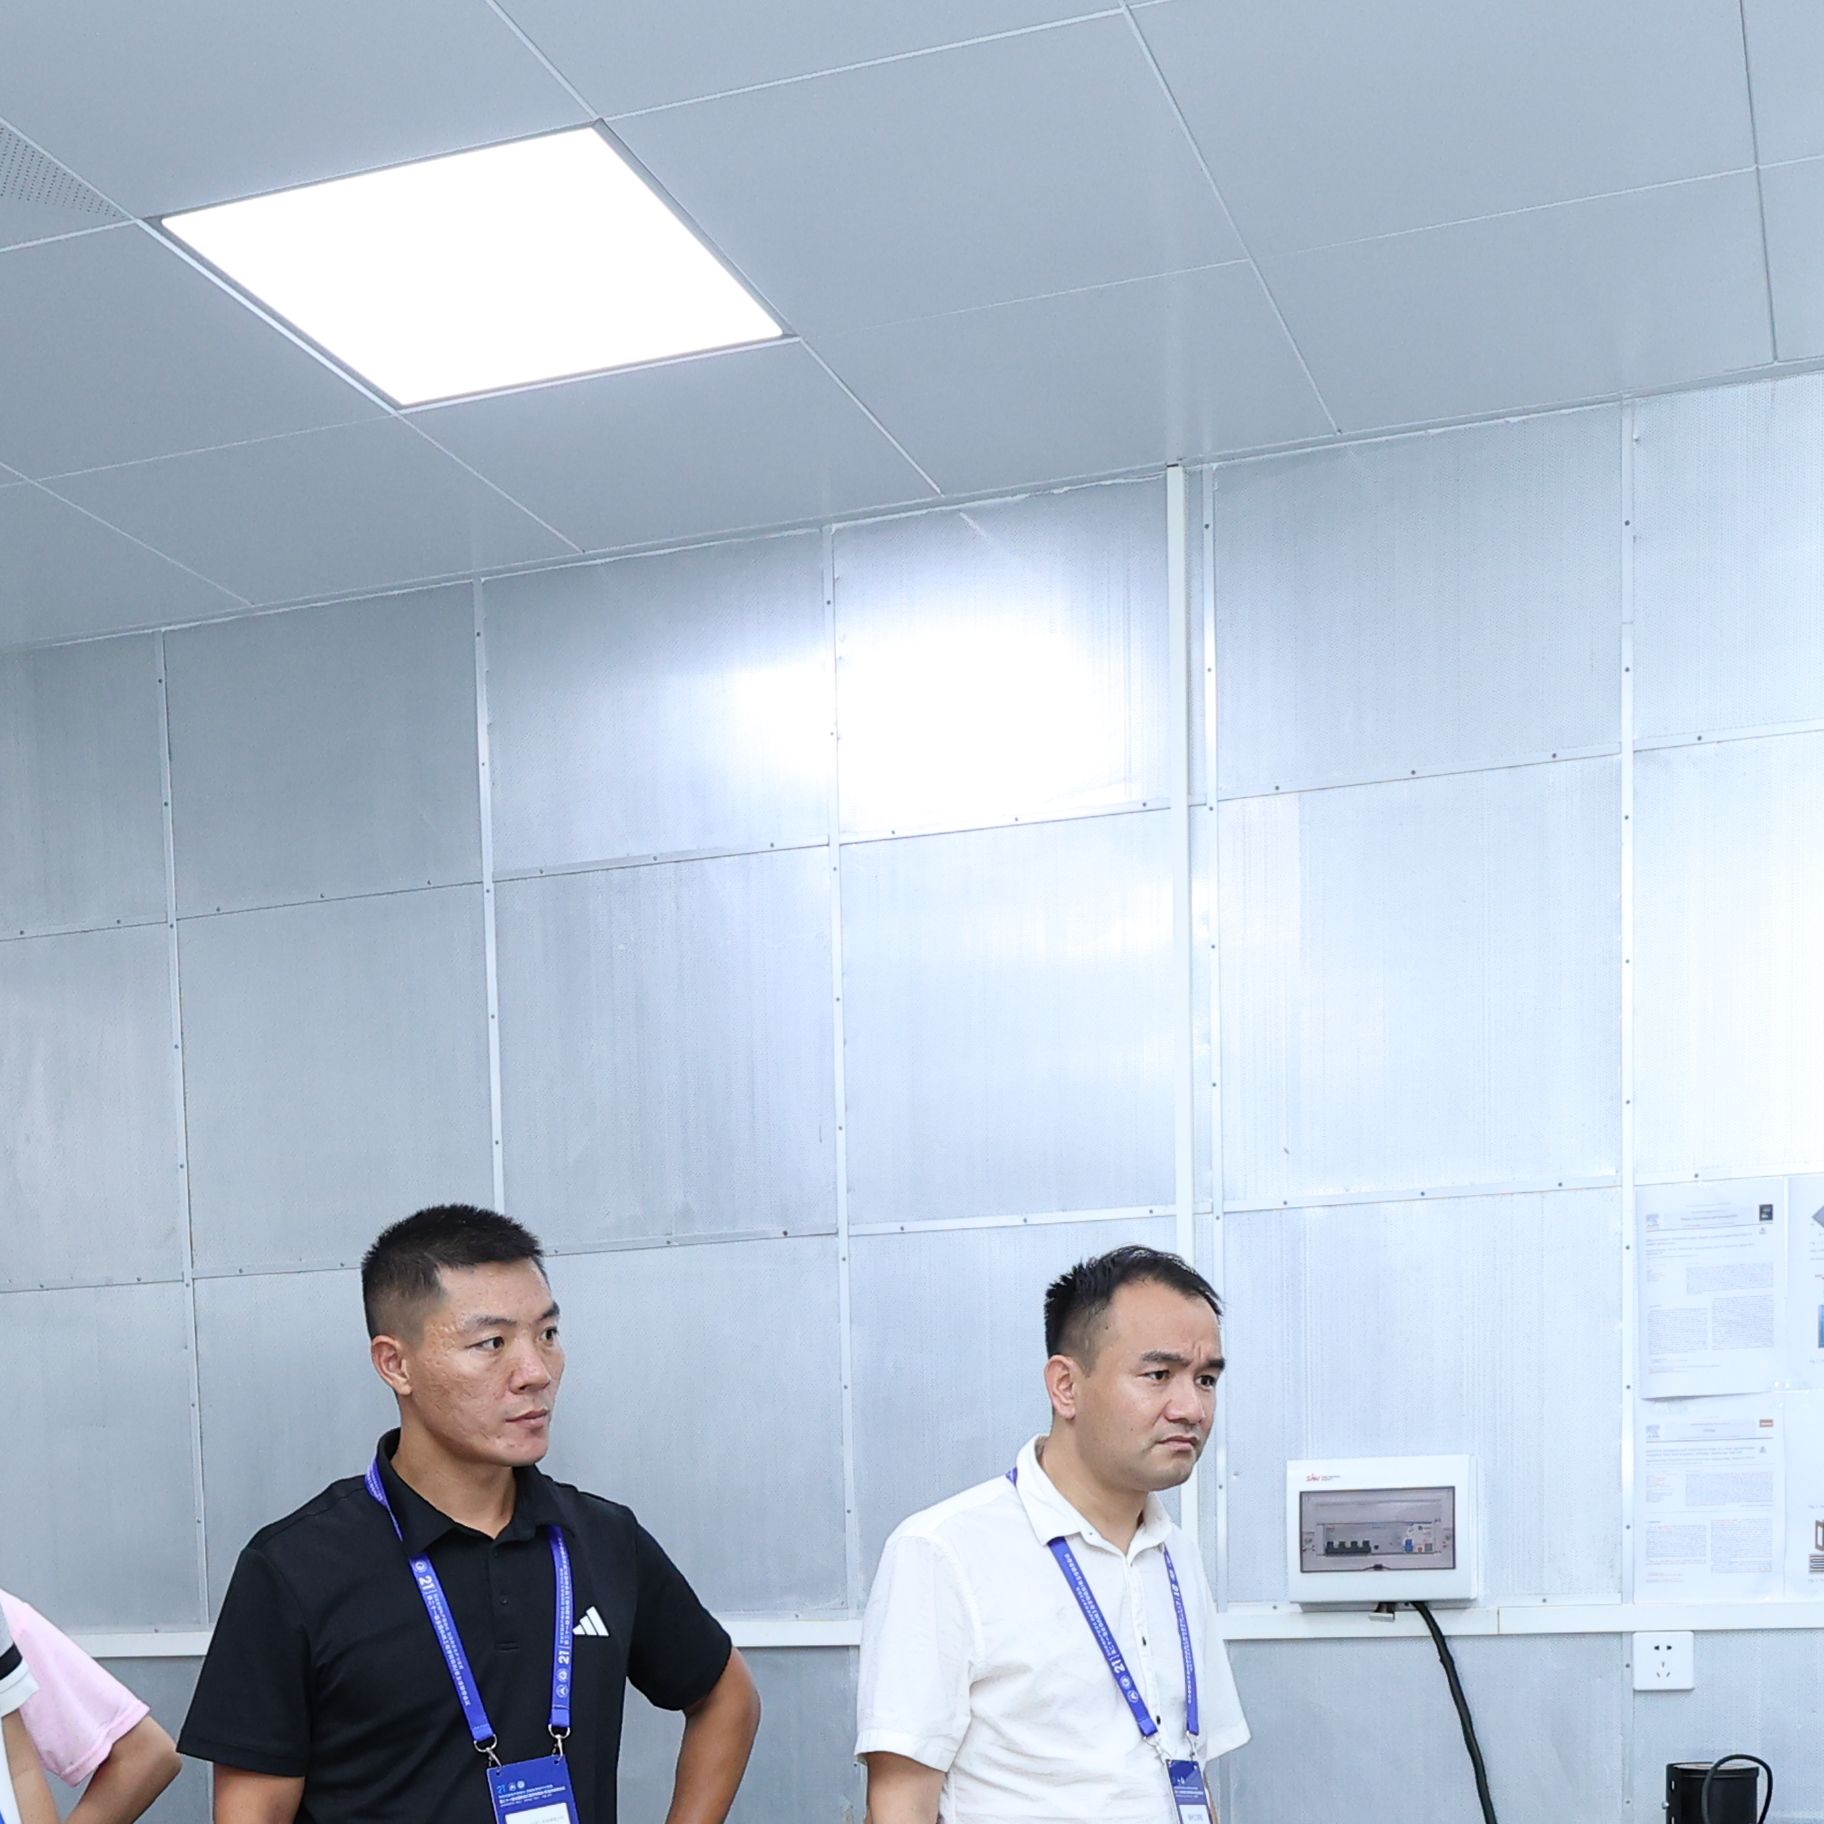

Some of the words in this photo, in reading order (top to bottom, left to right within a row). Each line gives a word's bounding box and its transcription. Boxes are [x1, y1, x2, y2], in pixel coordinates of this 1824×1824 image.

[419, 1575, 436, 1590] 21
[558, 1650, 570, 1664] 21
[1111, 1658, 1126, 1674] 21
